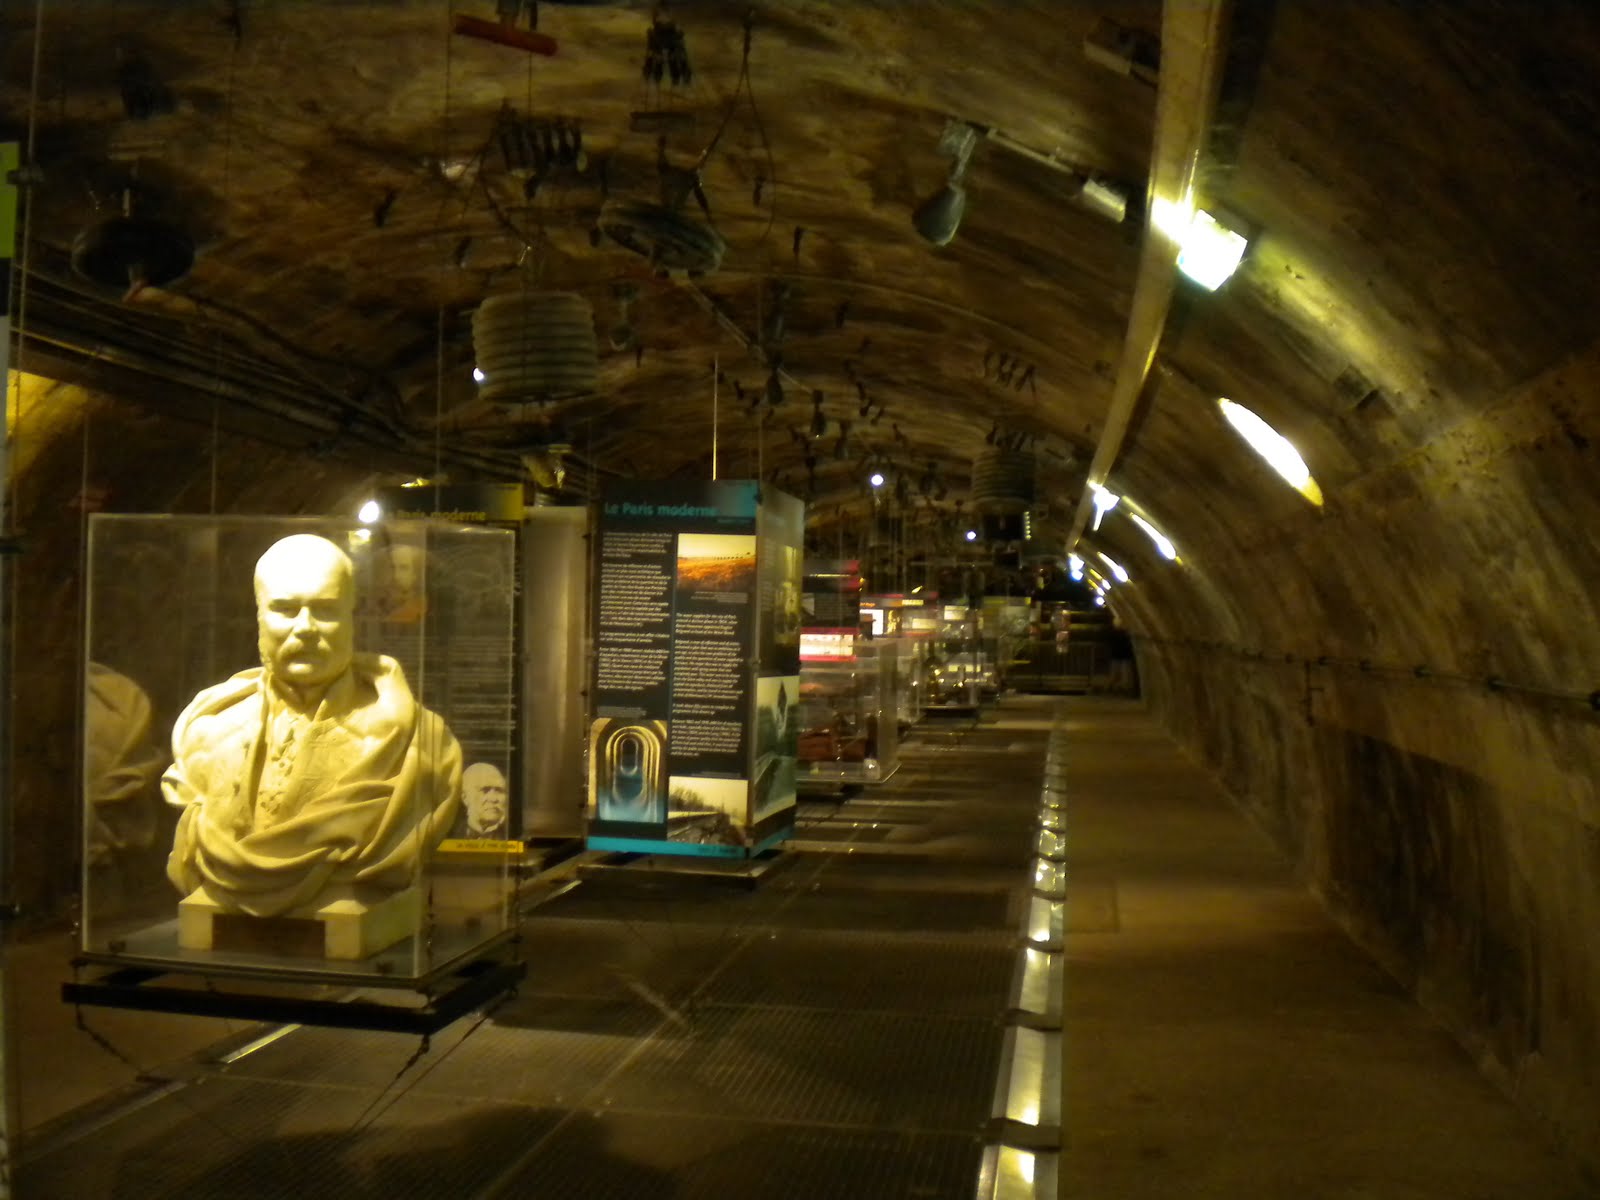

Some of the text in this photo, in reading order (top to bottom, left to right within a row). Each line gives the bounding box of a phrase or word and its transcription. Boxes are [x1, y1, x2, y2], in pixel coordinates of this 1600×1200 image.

[430, 508, 486, 521] moderne
[605, 502, 718, 517] Le Paris moderne
